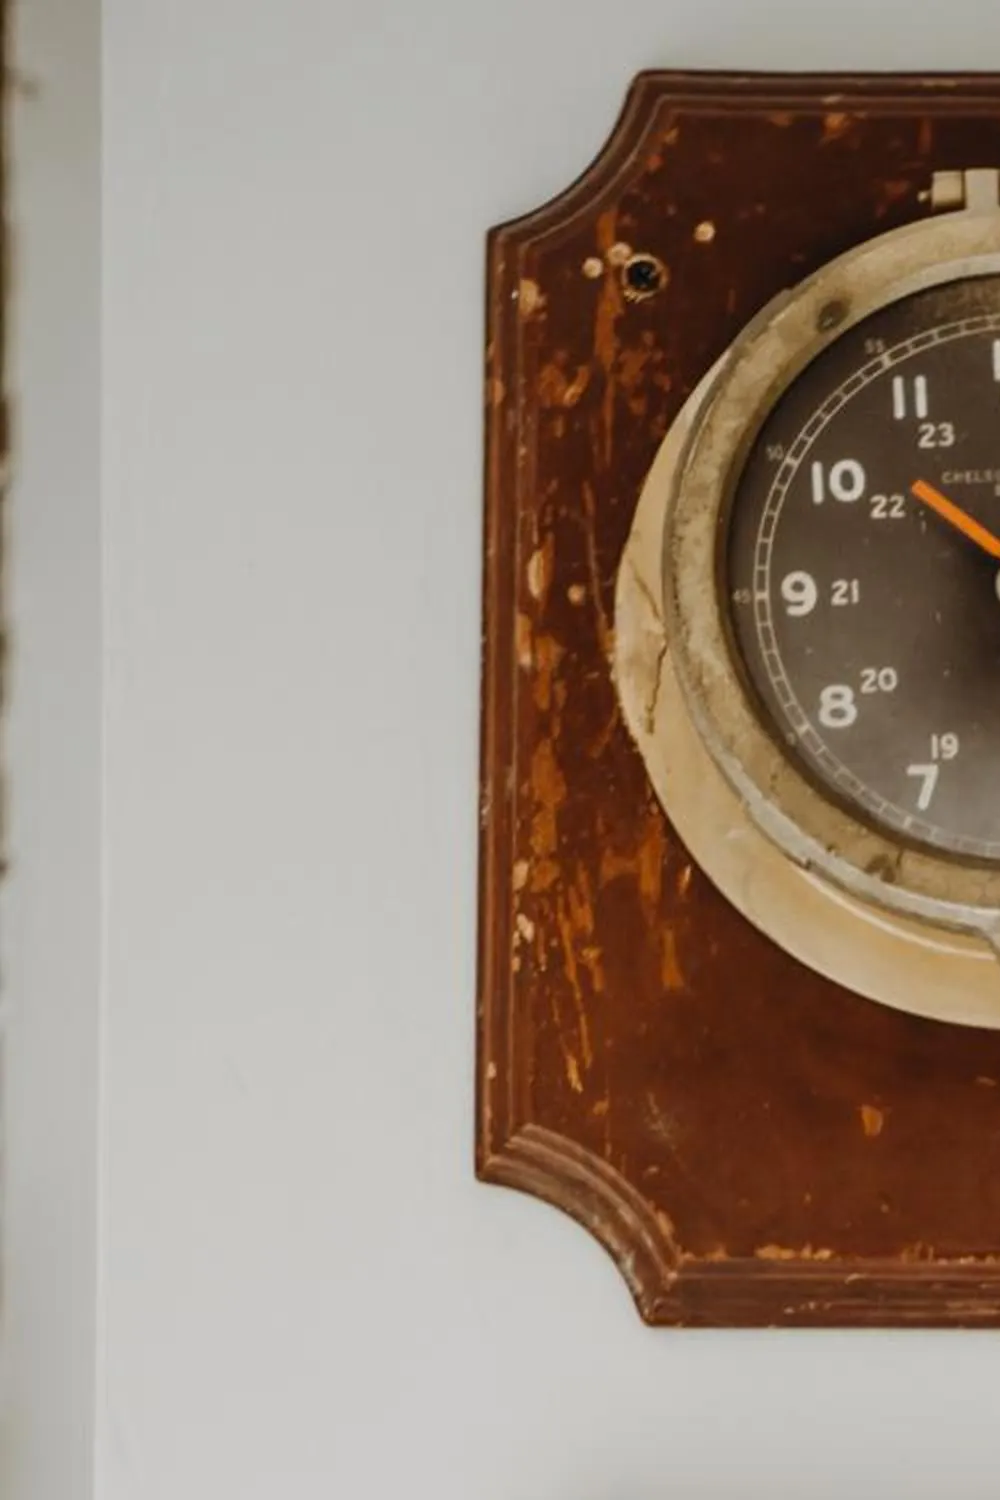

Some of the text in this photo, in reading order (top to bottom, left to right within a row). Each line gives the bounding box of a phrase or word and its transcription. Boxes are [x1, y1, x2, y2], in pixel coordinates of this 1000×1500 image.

[892, 375, 928, 420] 11
[917, 422, 955, 449] 23
[812, 460, 865, 503] 10
[871, 495, 904, 519] 22
[781, 571, 817, 616] 9
[832, 580, 858, 605] 21
[861, 668, 897, 693] 20
[819, 685, 857, 728] 8
[932, 734, 958, 759] 19
[907, 764, 938, 810] 7
